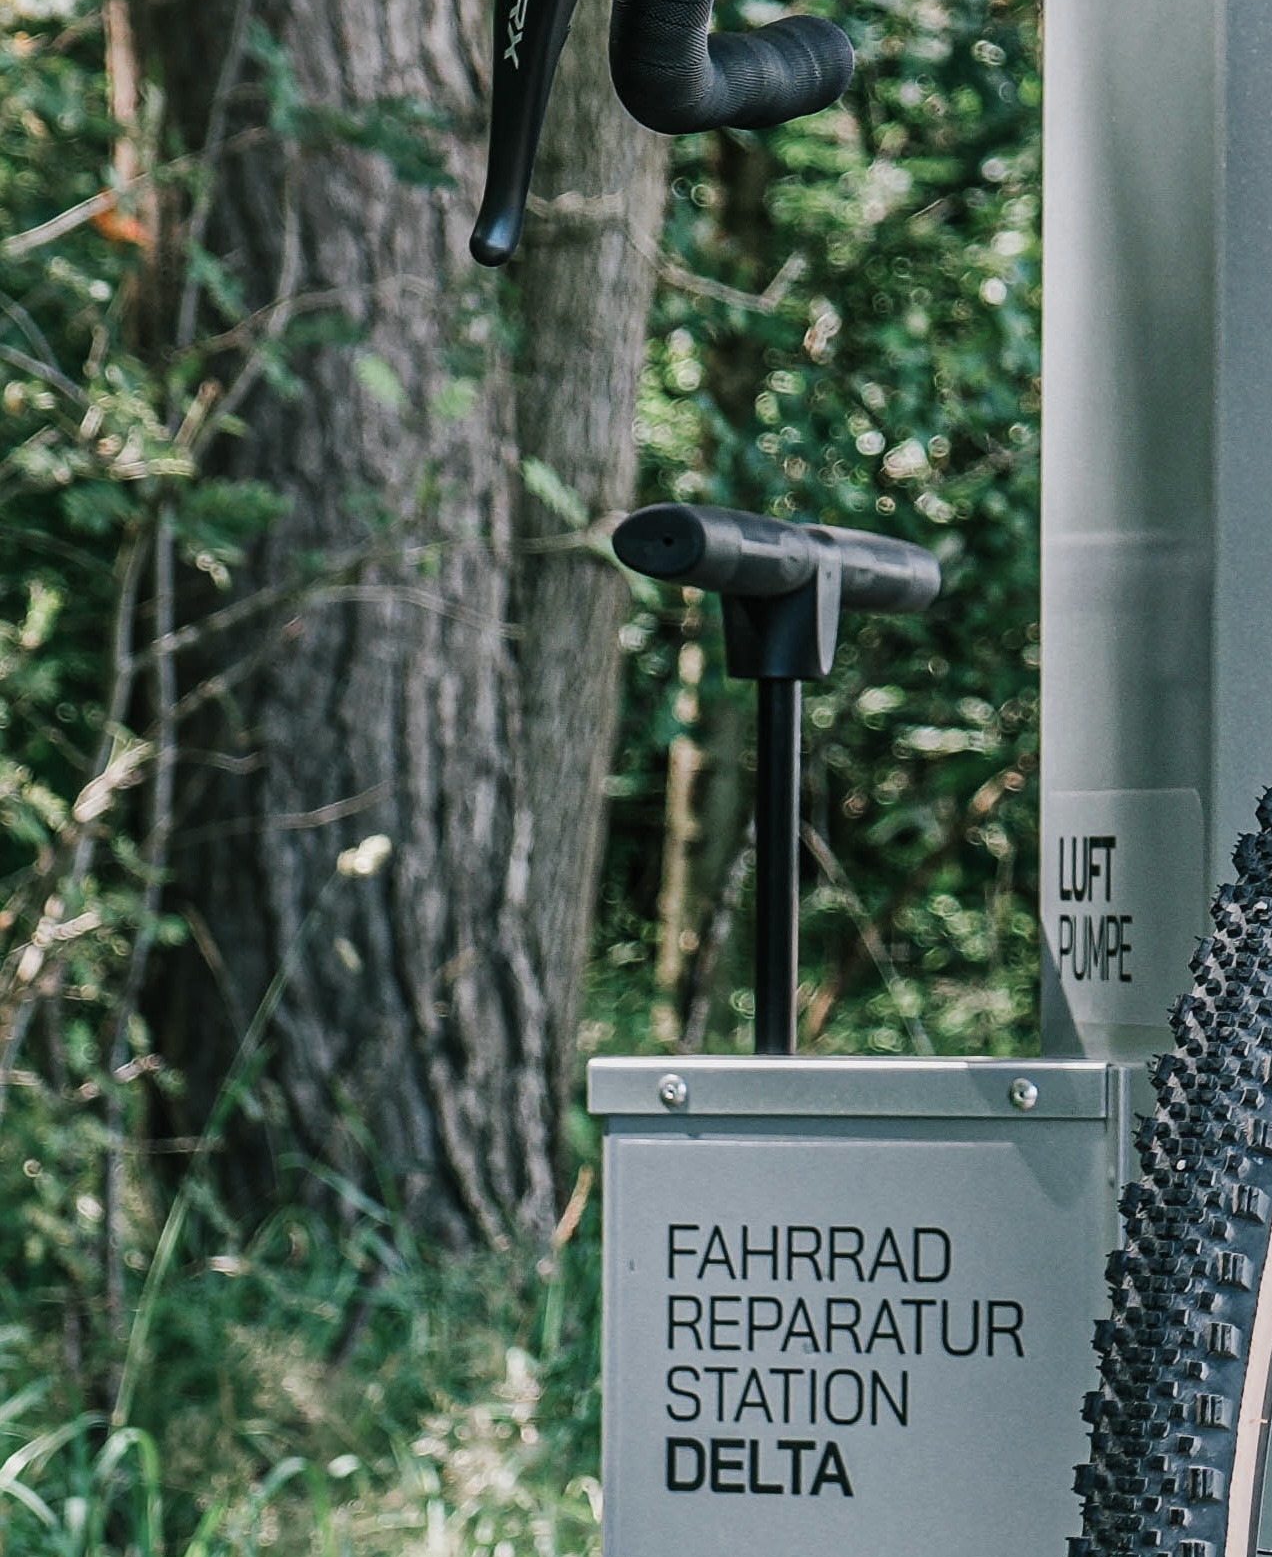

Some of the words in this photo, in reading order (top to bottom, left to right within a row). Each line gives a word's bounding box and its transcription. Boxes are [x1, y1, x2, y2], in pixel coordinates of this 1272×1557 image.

[1059, 836, 1116, 902] LUFT
[1059, 915, 1133, 982] PUMPE
[667, 1223, 952, 1283] FAHRRAD
[667, 1295, 1025, 1357] REPARATUR
[666, 1365, 908, 1426] STATION
[665, 1436, 855, 1497] DELTA
